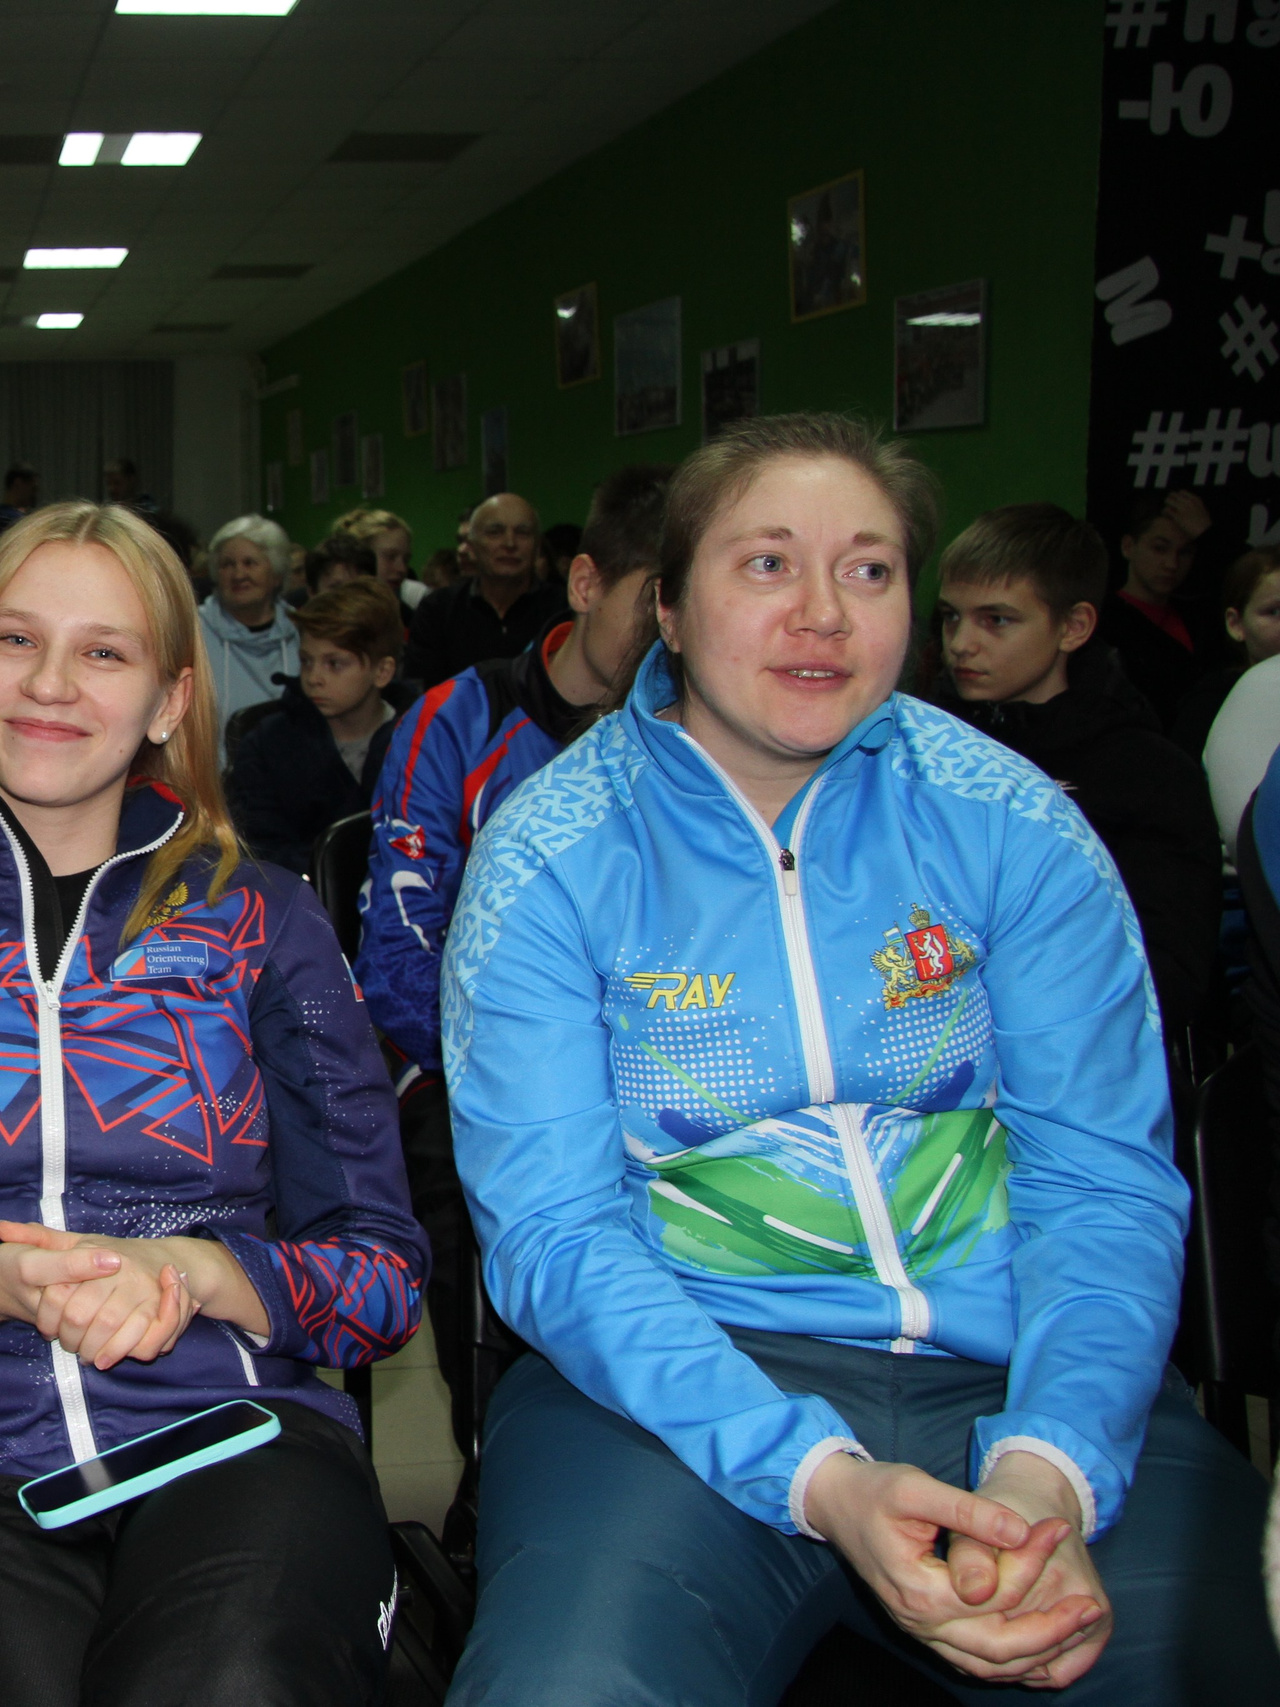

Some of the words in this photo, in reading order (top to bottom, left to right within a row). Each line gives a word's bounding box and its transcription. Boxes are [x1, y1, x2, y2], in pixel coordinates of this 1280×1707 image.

[146, 944, 181, 954] Russian
[147, 955, 205, 965] Orienteering
[148, 966, 172, 974] Team
[623, 972, 734, 1010] RAY
